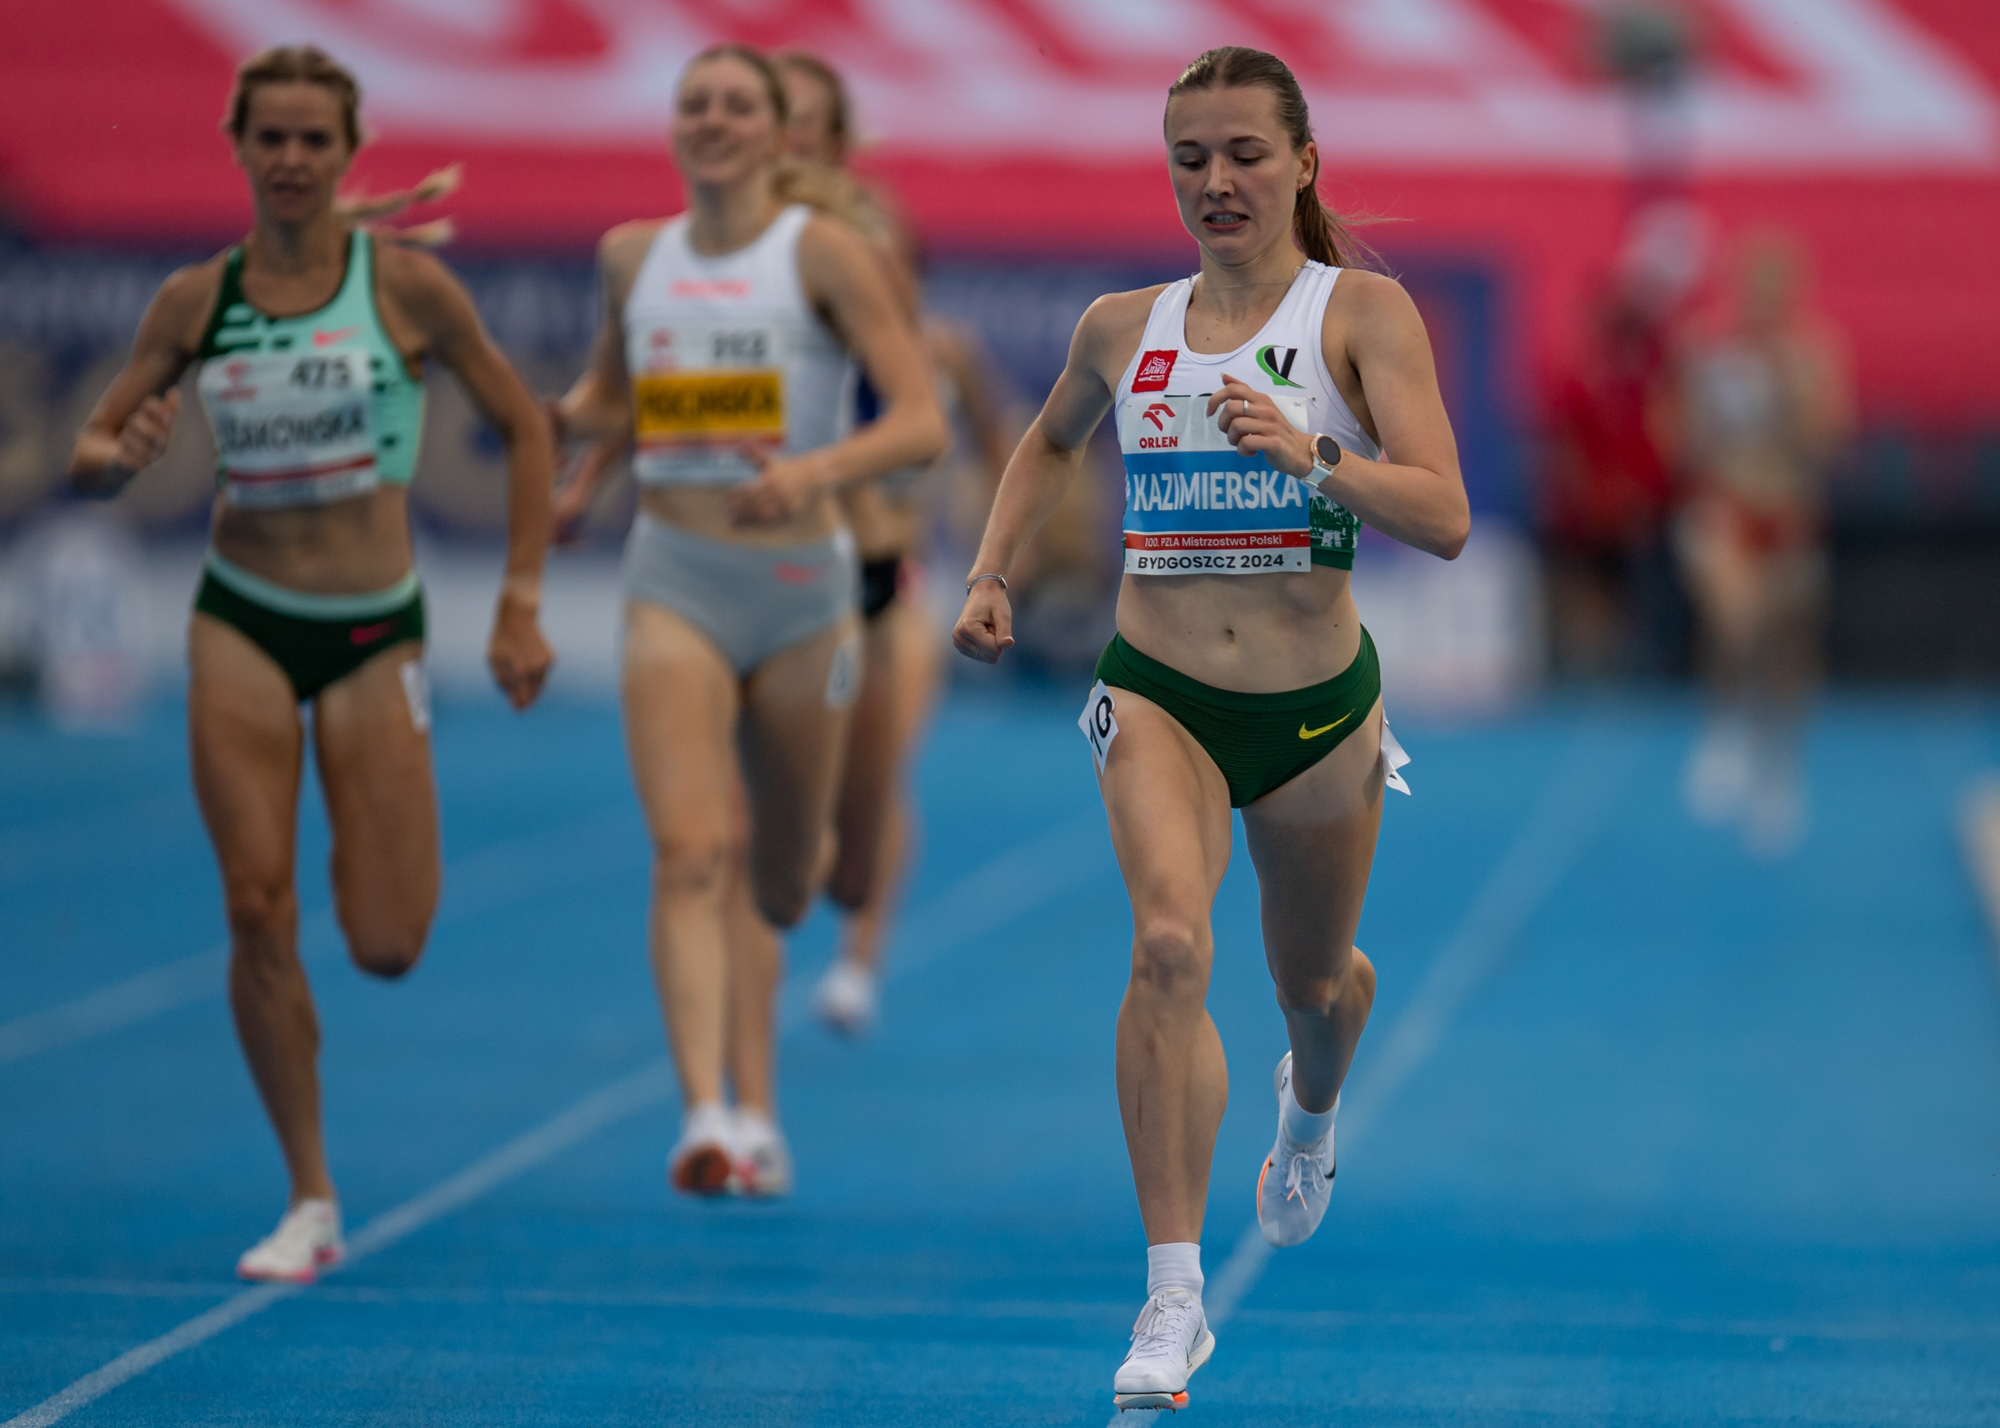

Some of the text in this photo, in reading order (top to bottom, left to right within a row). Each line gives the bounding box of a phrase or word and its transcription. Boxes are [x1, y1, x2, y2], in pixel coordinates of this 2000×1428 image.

[1138, 436, 1179, 449] ORLEN
[1132, 470, 1303, 512] KAZIMIERSKA
[1144, 534, 1283, 548] 100. PZLA Mistrzostwa Polski
[1137, 554, 1284, 569] BYDGOSZCZ 2024
